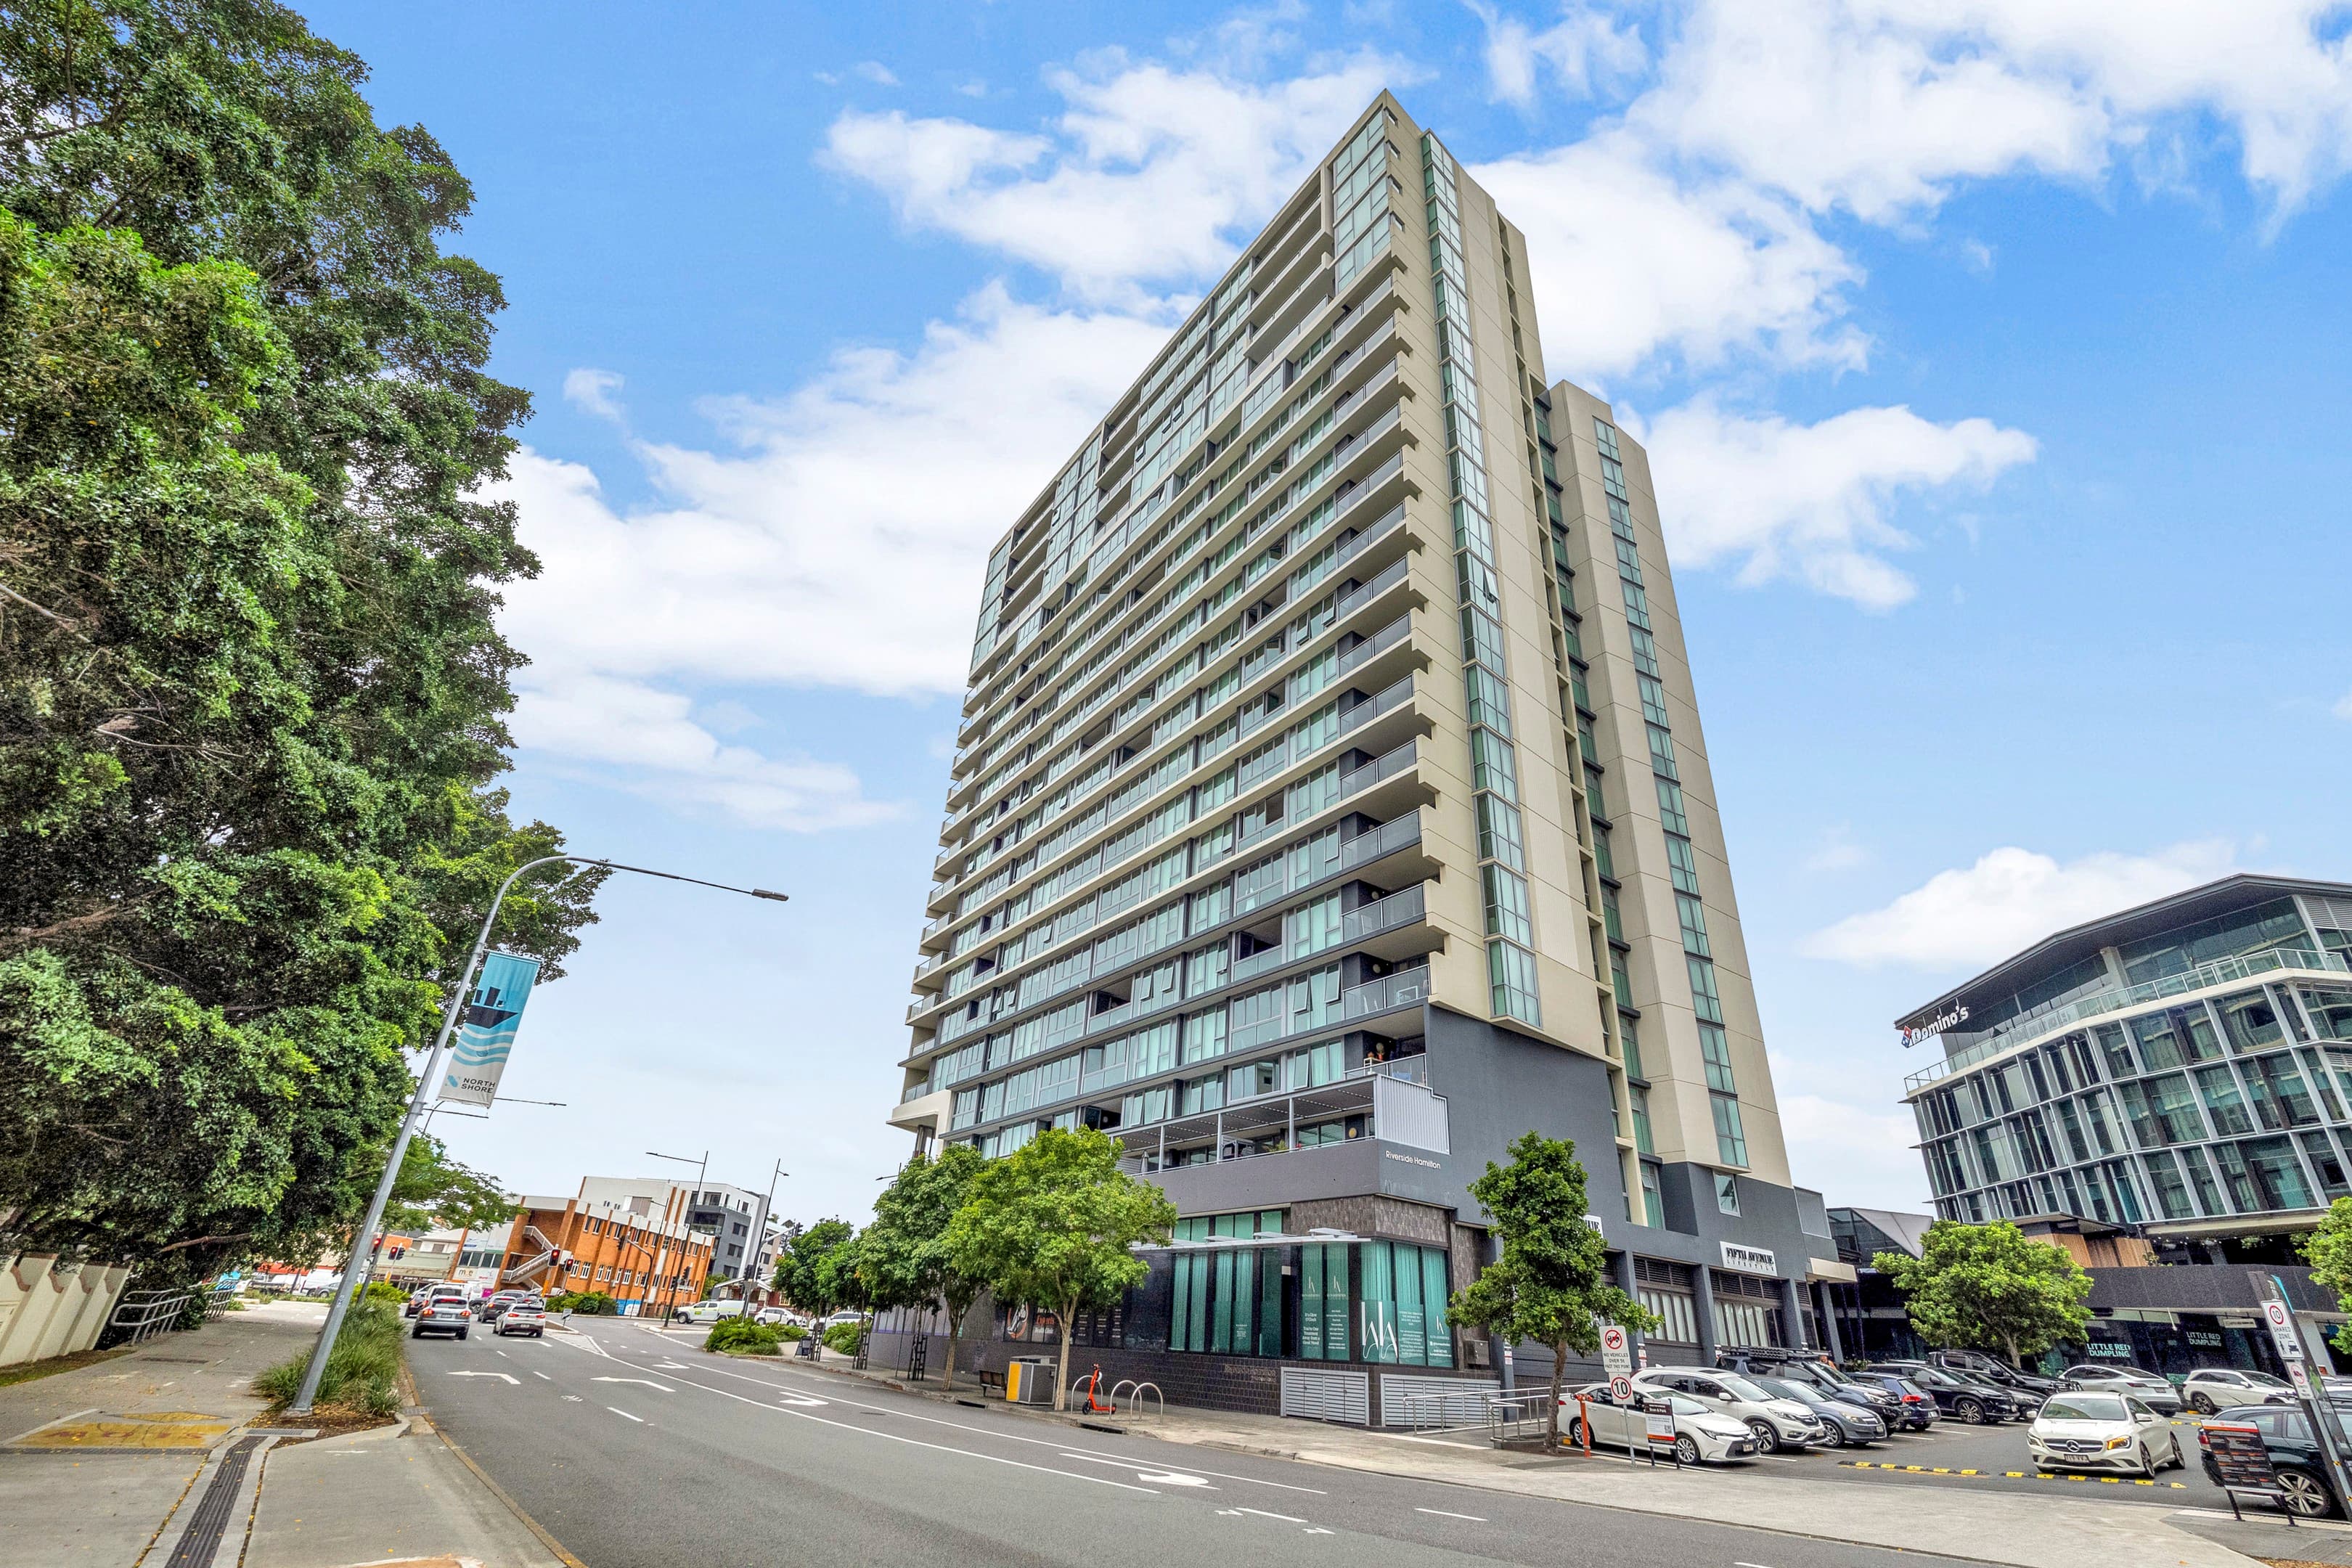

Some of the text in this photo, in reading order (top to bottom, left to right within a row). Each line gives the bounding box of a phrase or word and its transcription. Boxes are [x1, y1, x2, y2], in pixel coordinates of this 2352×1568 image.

[1911, 1005, 1969, 1044] Domino's
[463, 1077, 496, 1087] NORTH
[461, 1084, 494, 1093] SHORE
[1386, 1150, 1441, 1169] Riverside Hamilton
[1726, 1247, 1774, 1265] FIFTH AVENUE
[2272, 1310, 2281, 1319] 10
[2189, 1338, 2221, 1347] DUMPLING
[1614, 1381, 1628, 1395] 10
